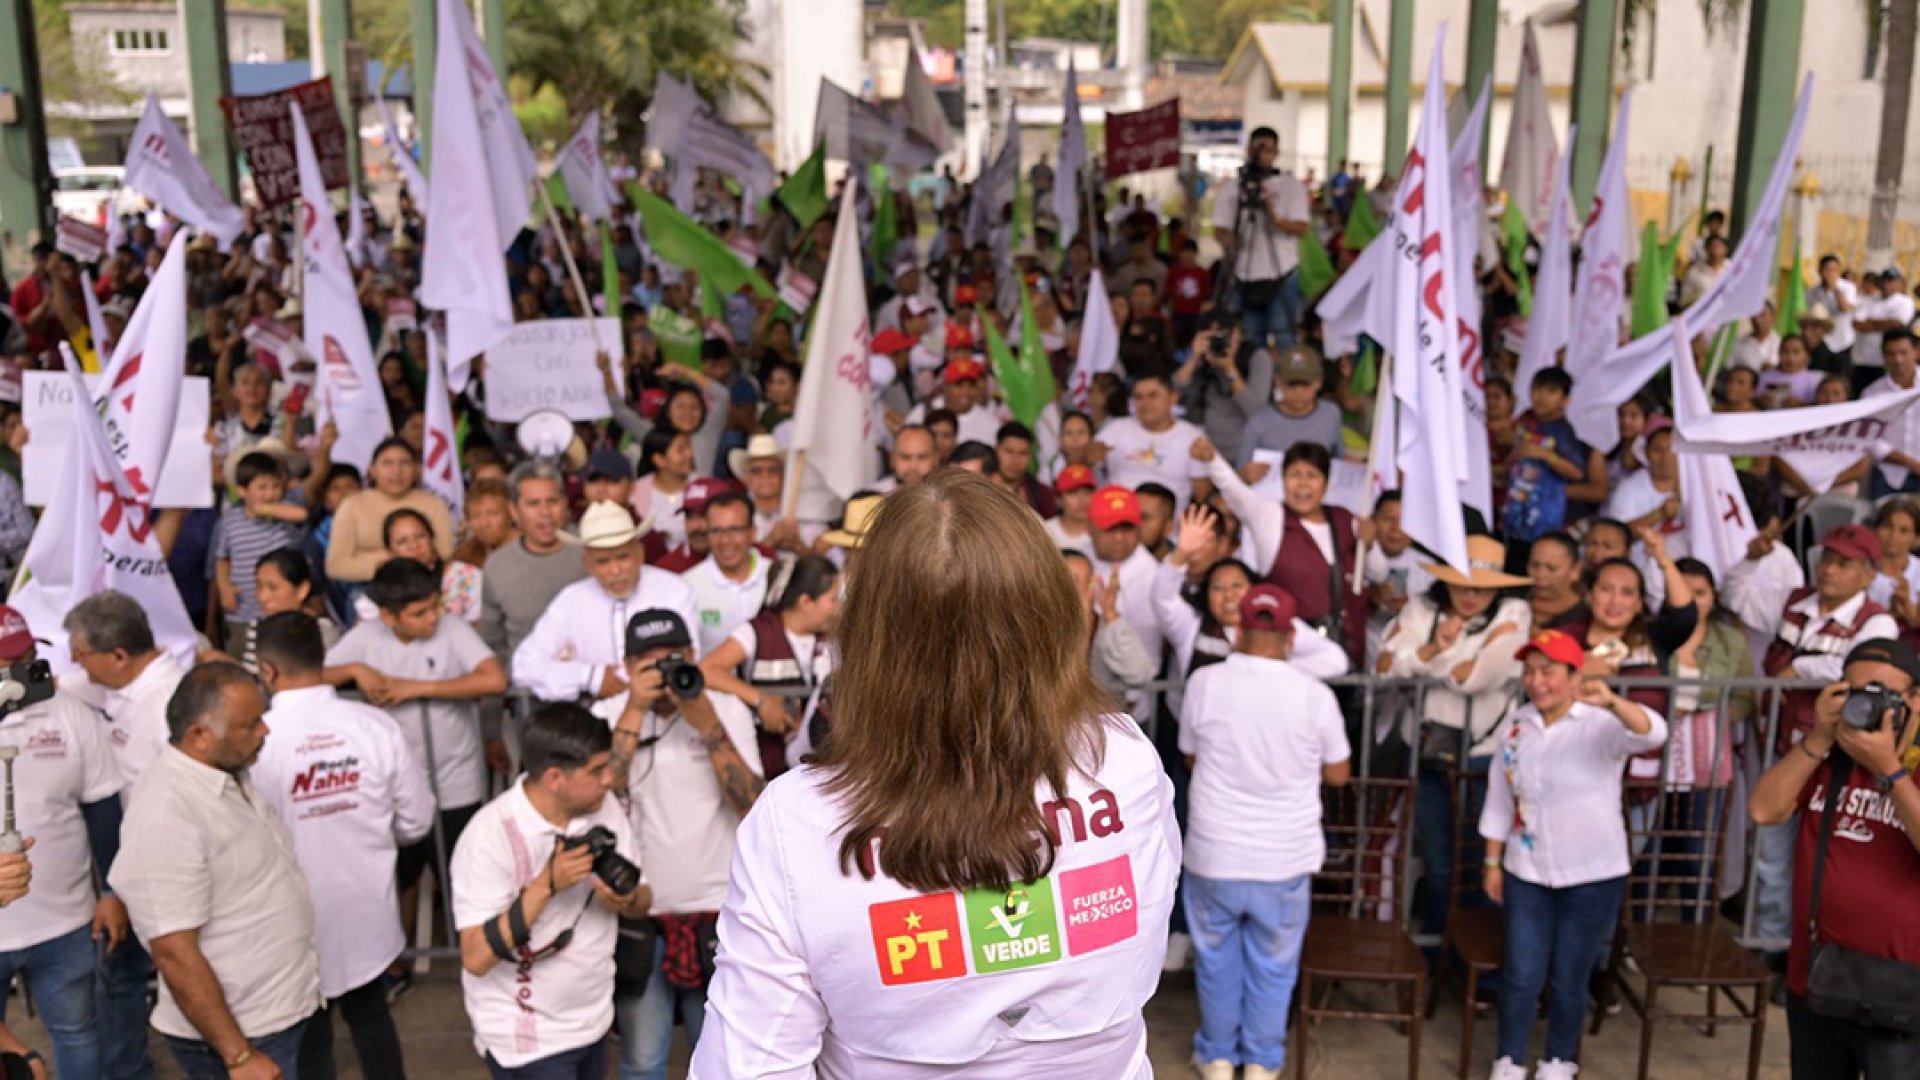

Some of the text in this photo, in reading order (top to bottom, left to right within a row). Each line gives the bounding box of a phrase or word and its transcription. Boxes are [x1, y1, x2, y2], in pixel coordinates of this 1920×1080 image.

[1073, 886, 1126, 910] FUERZA
[887, 929, 949, 975] PT
[982, 933, 1052, 964] VERDE
